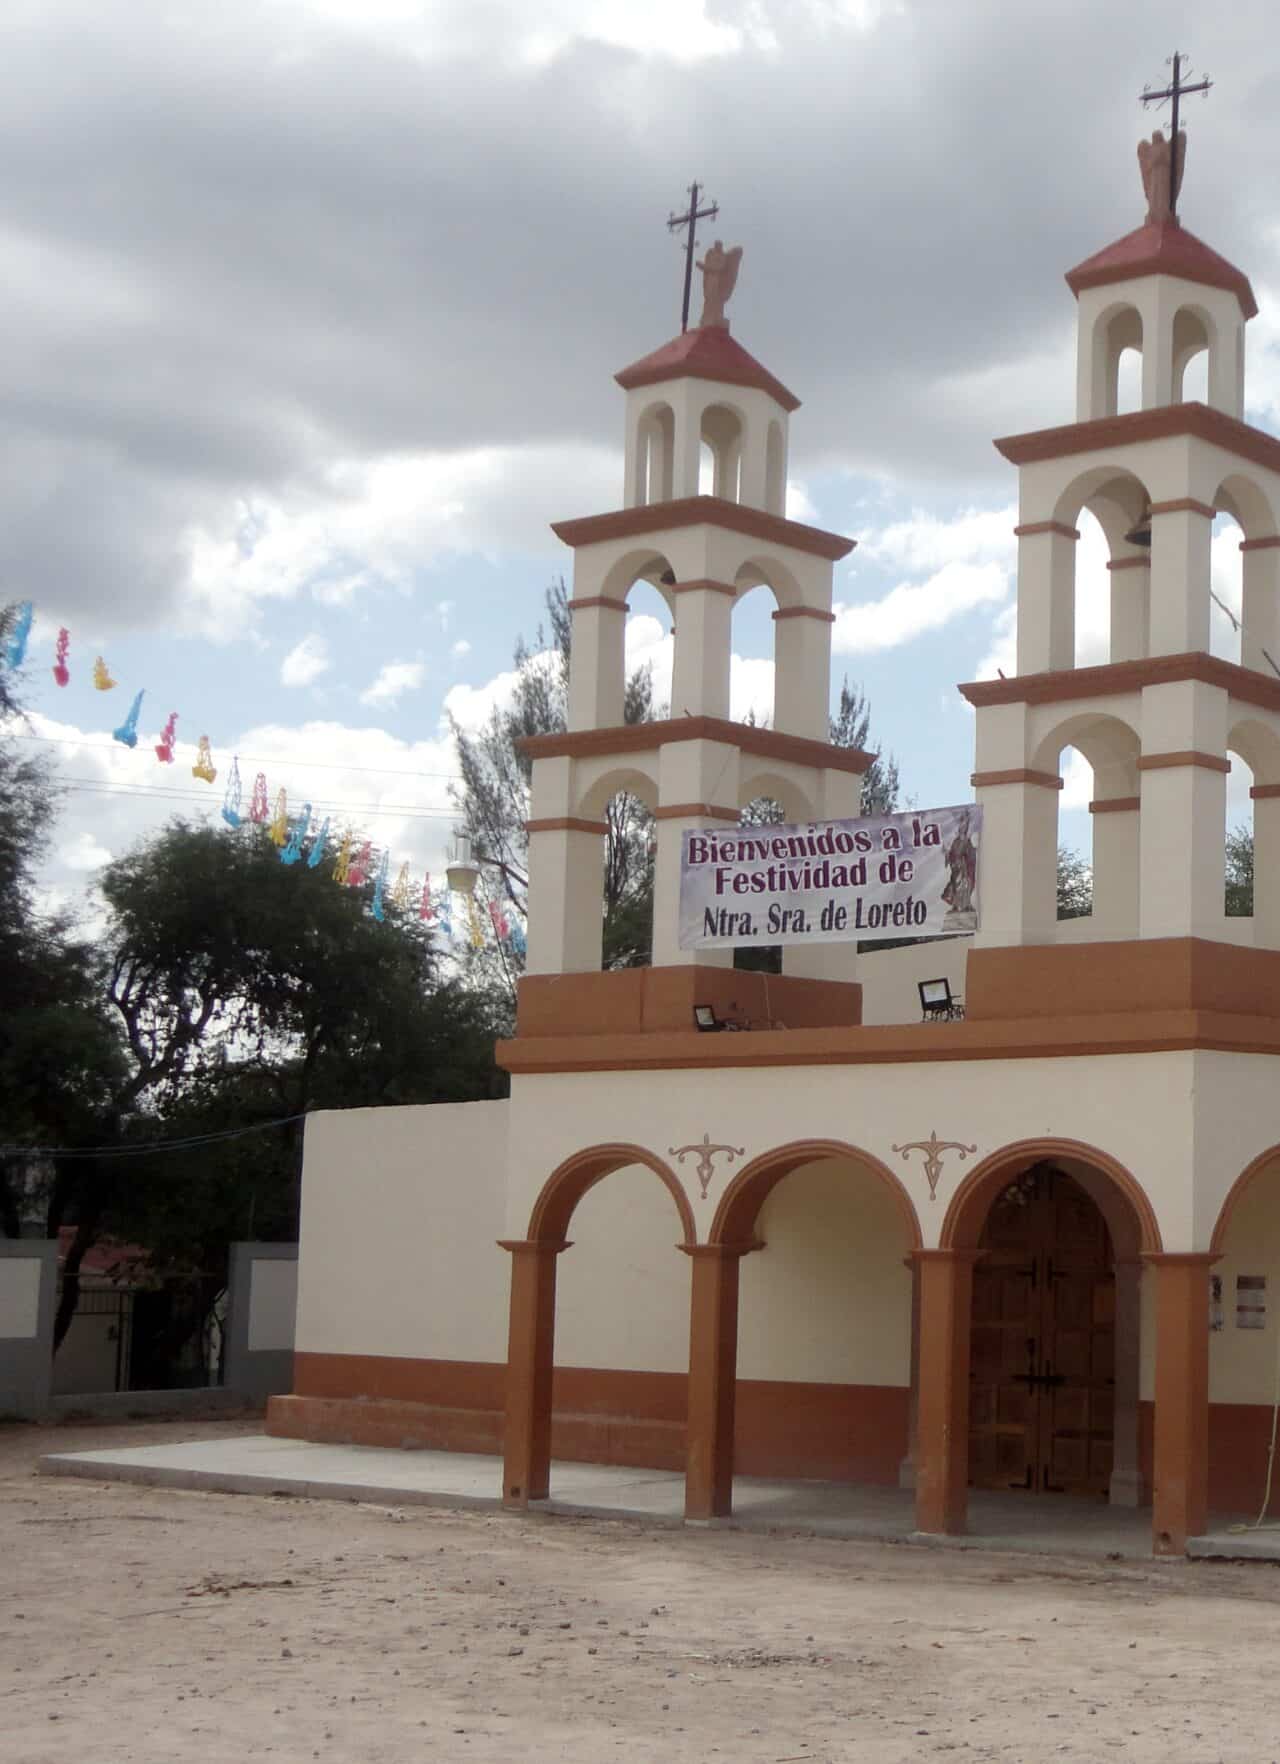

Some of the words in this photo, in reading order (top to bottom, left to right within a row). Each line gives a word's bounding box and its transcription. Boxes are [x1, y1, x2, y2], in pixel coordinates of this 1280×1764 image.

[688, 827, 872, 864] Bienvenidos
[881, 827, 900, 850] a
[912, 819, 941, 847] la
[715, 857, 866, 895] Festividad
[879, 855, 913, 884] de
[703, 906, 758, 937] Ntra.
[767, 903, 811, 934] Sra.
[820, 899, 847, 931] de
[855, 895, 927, 929] Loreto
